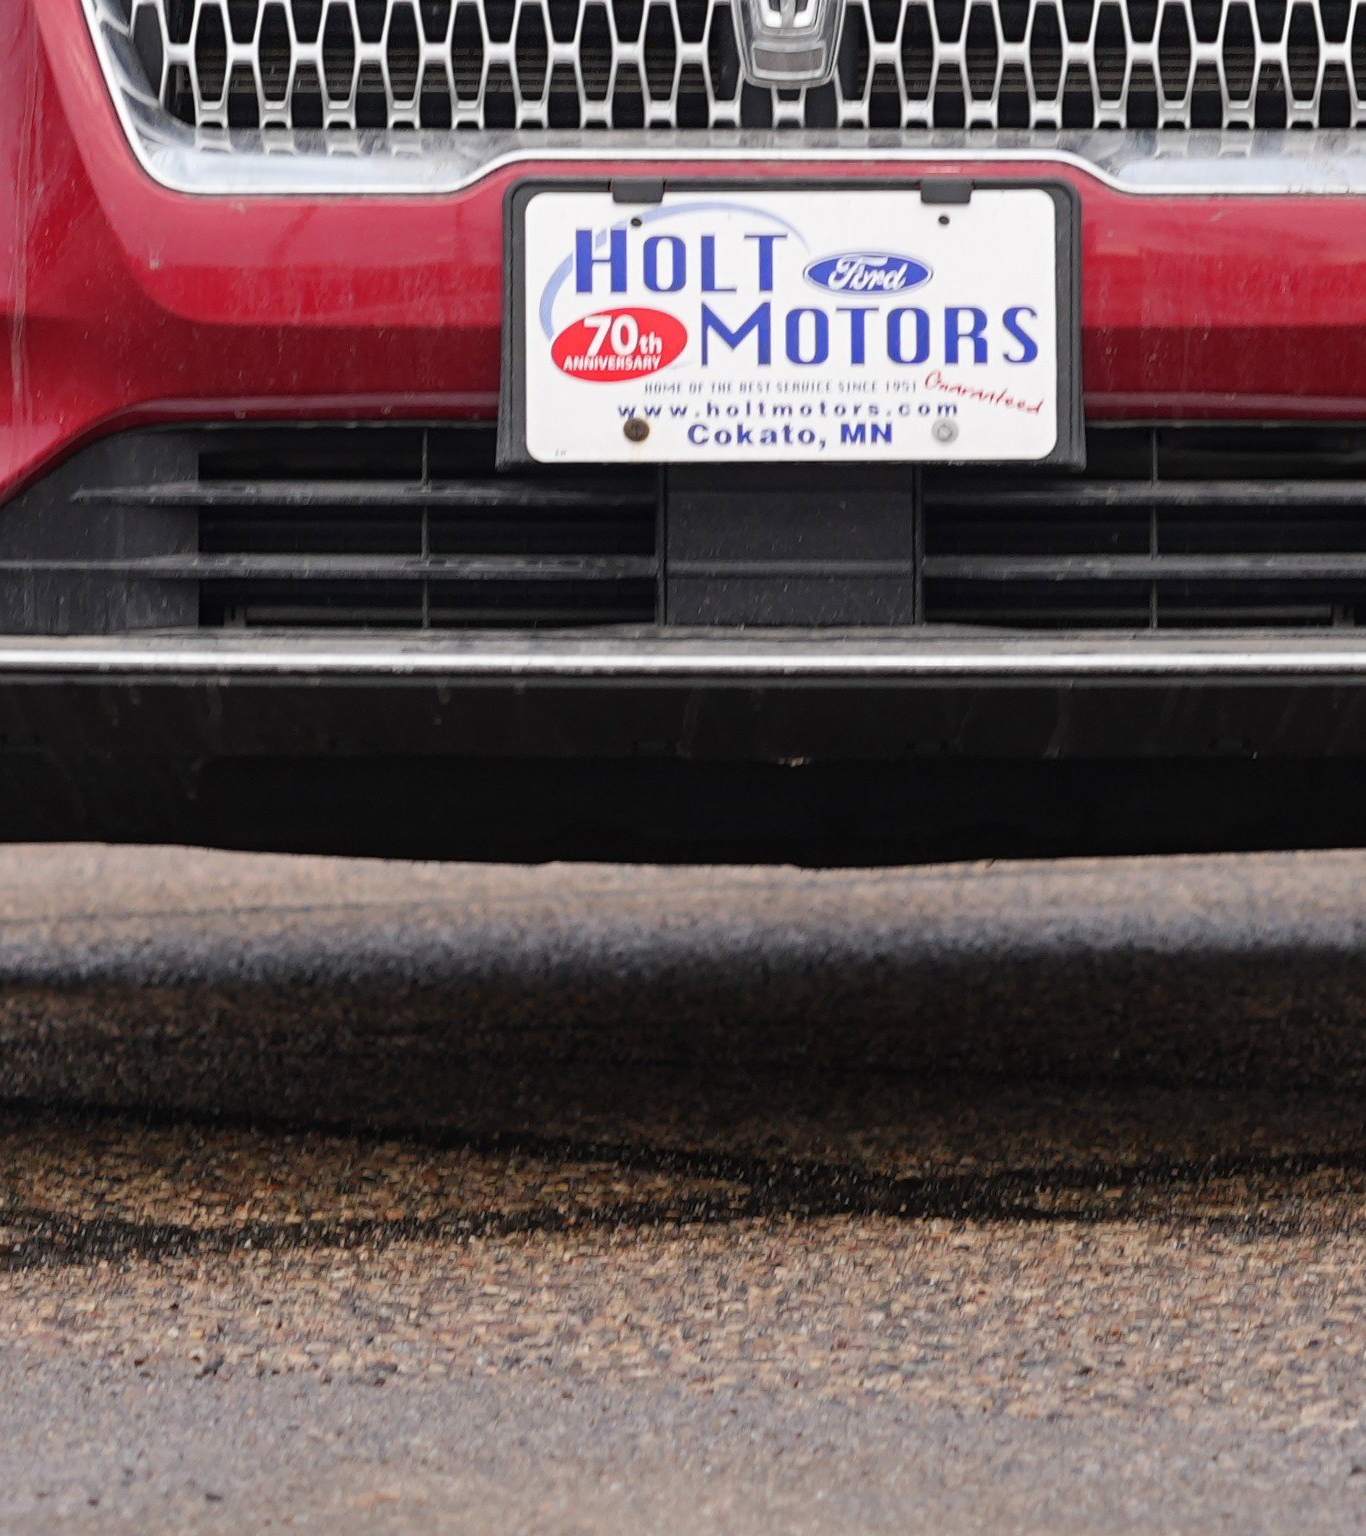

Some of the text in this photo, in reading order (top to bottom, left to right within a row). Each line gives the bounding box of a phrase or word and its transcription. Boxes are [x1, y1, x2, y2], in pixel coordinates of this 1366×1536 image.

[575, 227, 788, 294] HOLT
[827, 255, 909, 291] Ford
[583, 313, 663, 357] 70th
[700, 301, 1038, 366] MOTORS
[562, 354, 662, 372] ANNIVERSARY
[644, 380, 683, 395] HOME
[688, 380, 705, 395] OF
[711, 380, 733, 395] THE
[739, 380, 772, 395] BEST
[776, 380, 832, 395] SERVICE
[838, 380, 877, 395] SINCE
[617, 401, 958, 419] www.holtmotors.com
[687, 423, 894, 450] Cokato, MN
